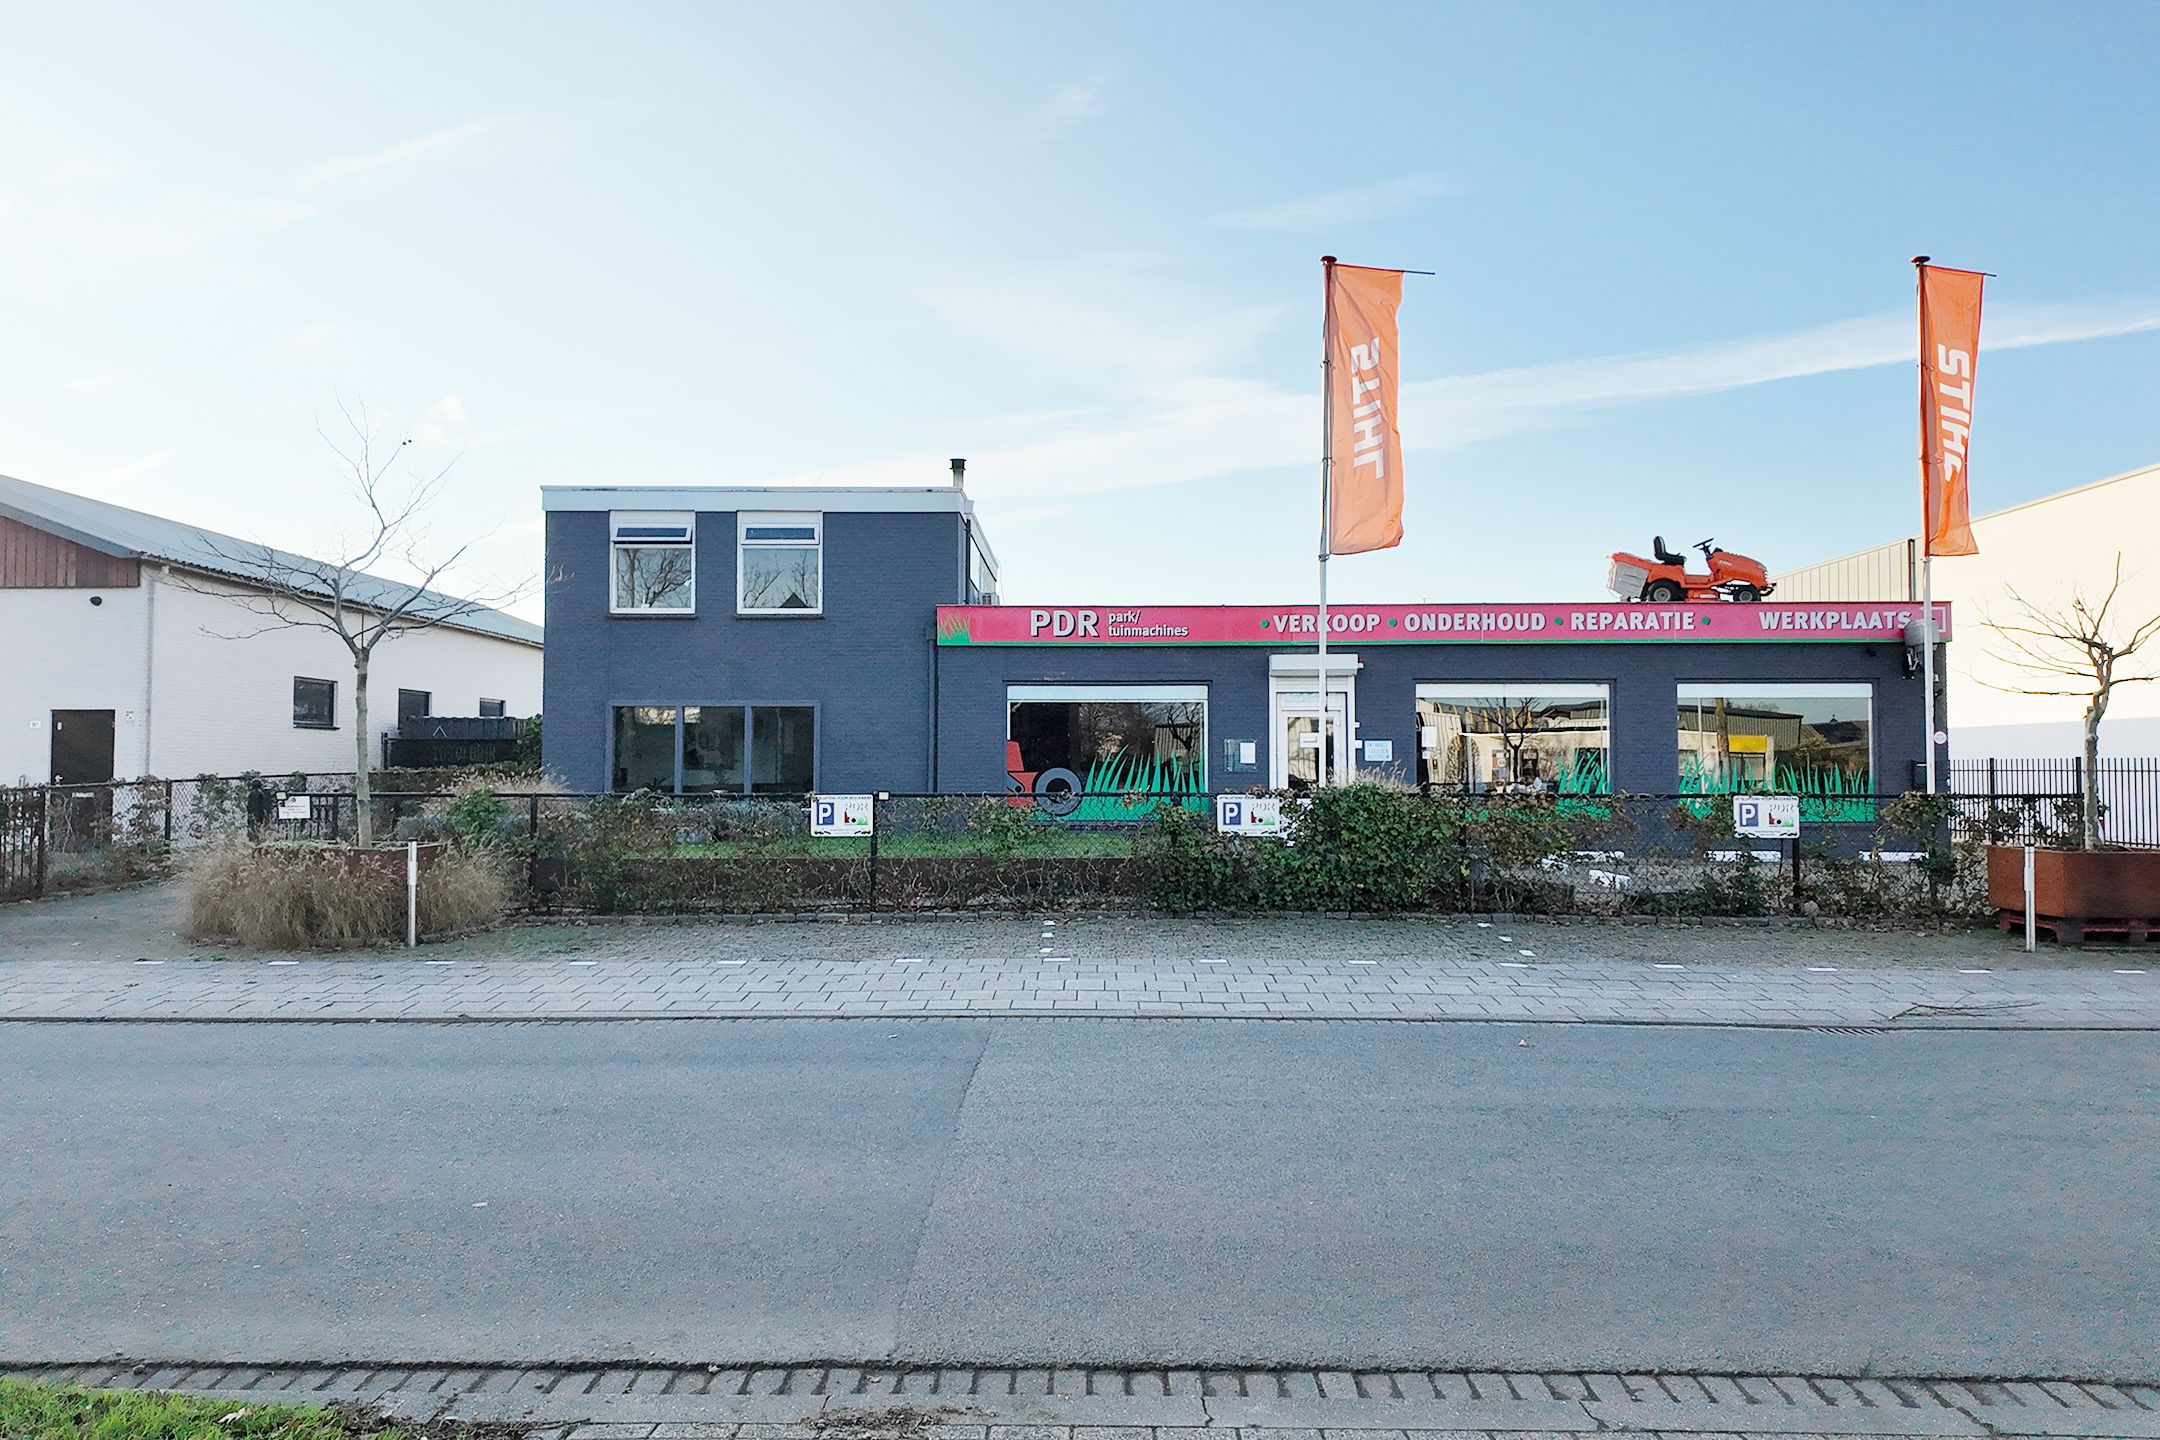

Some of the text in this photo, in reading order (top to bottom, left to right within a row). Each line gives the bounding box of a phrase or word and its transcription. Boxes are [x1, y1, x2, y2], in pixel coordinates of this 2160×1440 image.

[1937, 343, 1971, 482] STIHL
[1030, 609, 1099, 637] PDR
[1108, 609, 1141, 624] park/
[1272, 611, 1911, 633] VERKOOP ONDERHOUD REPARATIE WERKPLAATS
[1108, 624, 1189, 637] tuinmachines
[818, 803, 832, 825] P
[1225, 803, 1239, 824] P
[1741, 804, 1756, 826] P
